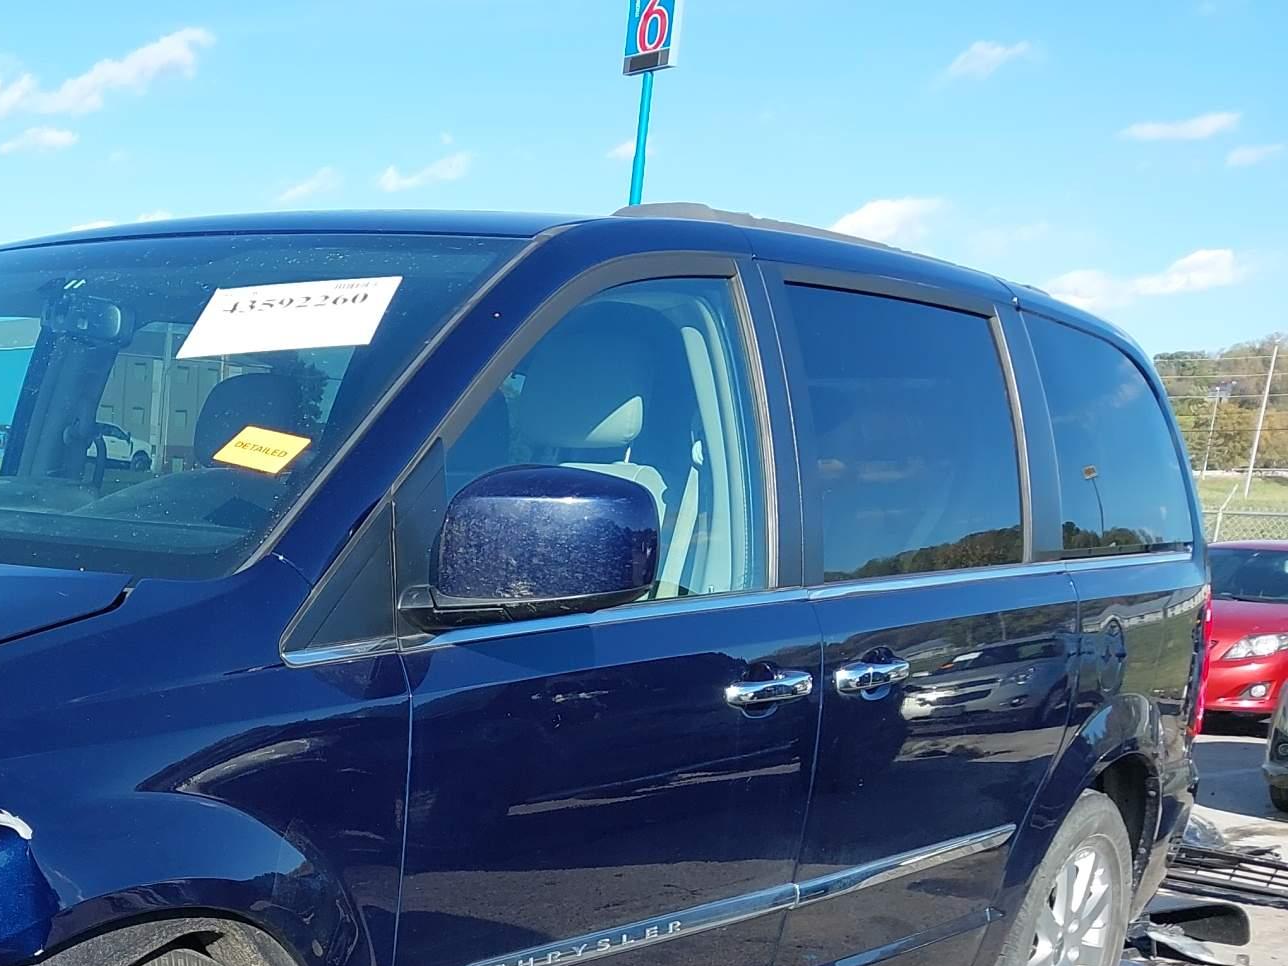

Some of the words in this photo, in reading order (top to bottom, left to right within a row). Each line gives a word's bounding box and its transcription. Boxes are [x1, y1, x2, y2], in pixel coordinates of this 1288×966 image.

[637, 0, 669, 53] 6
[223, 292, 370, 315] 43592260
[234, 440, 289, 458] DETAILED
